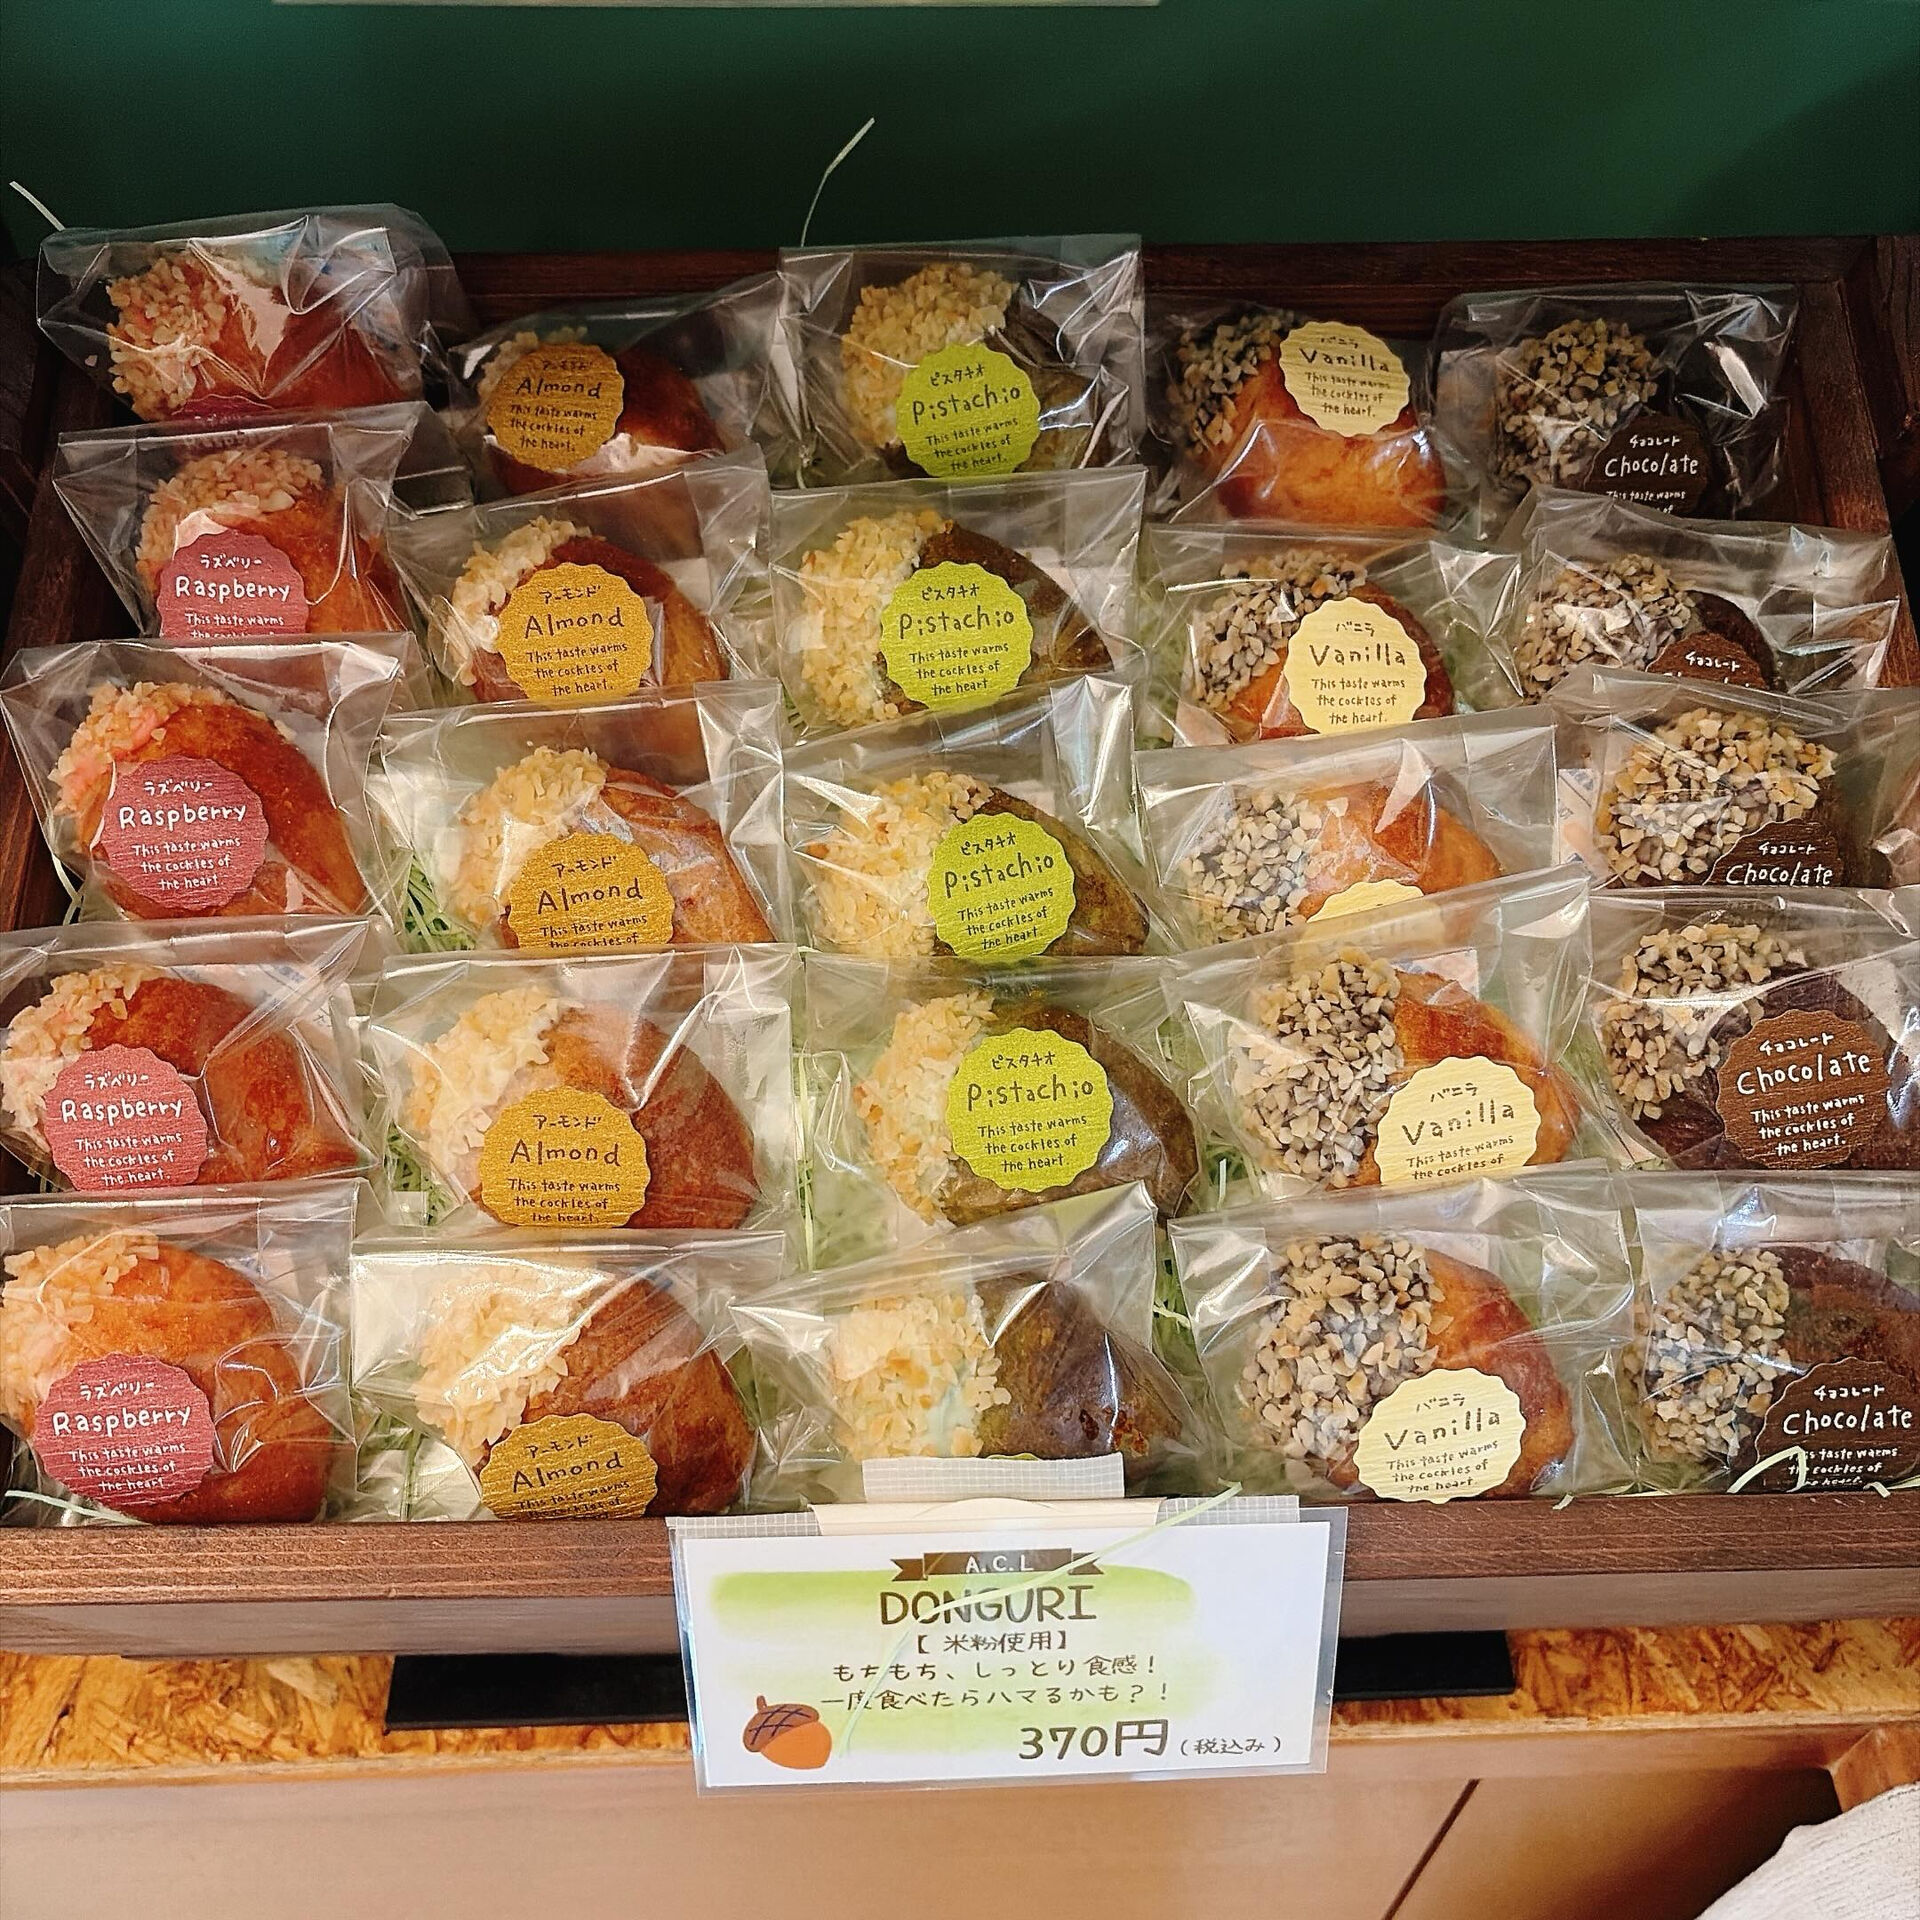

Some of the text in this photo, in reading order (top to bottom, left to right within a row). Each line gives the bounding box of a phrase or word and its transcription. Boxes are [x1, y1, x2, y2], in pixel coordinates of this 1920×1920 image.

[1605, 452, 1698, 477] Chocolate
[176, 576, 290, 604] Raspberry
[185, 613, 283, 627] This taste warms
[525, 607, 624, 639] Almond
[526, 643, 627, 663] This taste warms
[909, 643, 1008, 664] This taste warms
[1310, 644, 1405, 666] Vanilla
[535, 659, 619, 679] the cockles of
[916, 660, 1000, 679] the cockles of
[553, 685, 571, 696] the
[1312, 678, 1405, 690] This taste warms
[1317, 694, 1396, 706] the cockles of
[1329, 712, 1347, 724] the
[119, 804, 246, 831] Raspberry
[132, 838, 240, 857] This taste warms
[141, 854, 230, 873] the cockles of
[1726, 861, 1833, 886] Chocolate
[538, 878, 643, 914] Almond
[958, 888, 1053, 921] This taste warms
[540, 915, 647, 938] This taste warms
[966, 906, 1047, 936] the cockles of
[1736, 1051, 1871, 1095] Chocolate
[61, 1098, 182, 1126] Raspberry
[1751, 1094, 1864, 1124] This taste warms
[978, 1116, 1087, 1138] This taste warms
[1402, 1099, 1514, 1145] Vanilla
[1759, 1113, 1855, 1139] the cockles of
[75, 1133, 182, 1152] This taste warms
[510, 1139, 620, 1166] Almond
[985, 1134, 1077, 1154] the cockles of
[1406, 1136, 1513, 1168] This taste warms
[1775, 1143, 1798, 1156] the
[85, 1150, 174, 1168] the cockles of
[1001, 1160, 1023, 1173] the
[1412, 1154, 1504, 1180] the cockles of
[102, 1174, 123, 1185] the
[508, 1179, 620, 1192] This taste warms
[514, 1197, 608, 1209] the cockles of
[53, 1407, 190, 1437] Raspberry
[1384, 1408, 1500, 1450] Vanilla
[1783, 1405, 1912, 1435] Chocolate
[69, 1444, 185, 1462] This taste warms
[1387, 1441, 1498, 1470] This taste warms
[1819, 1448, 1852, 1460] taste
[1857, 1448, 1897, 1457] warms
[78, 1461, 176, 1477] the cockles of
[513, 1452, 623, 1493] Almond
[1393, 1459, 1489, 1482] the cockles of
[1813, 1464, 1862, 1474] cockles
[1867, 1462, 1882, 1472] of
[966, 1554, 1034, 1573] A.C.L
[880, 1585, 1096, 1625] DONGURI
[1019, 1719, 1168, 1760] 370円
